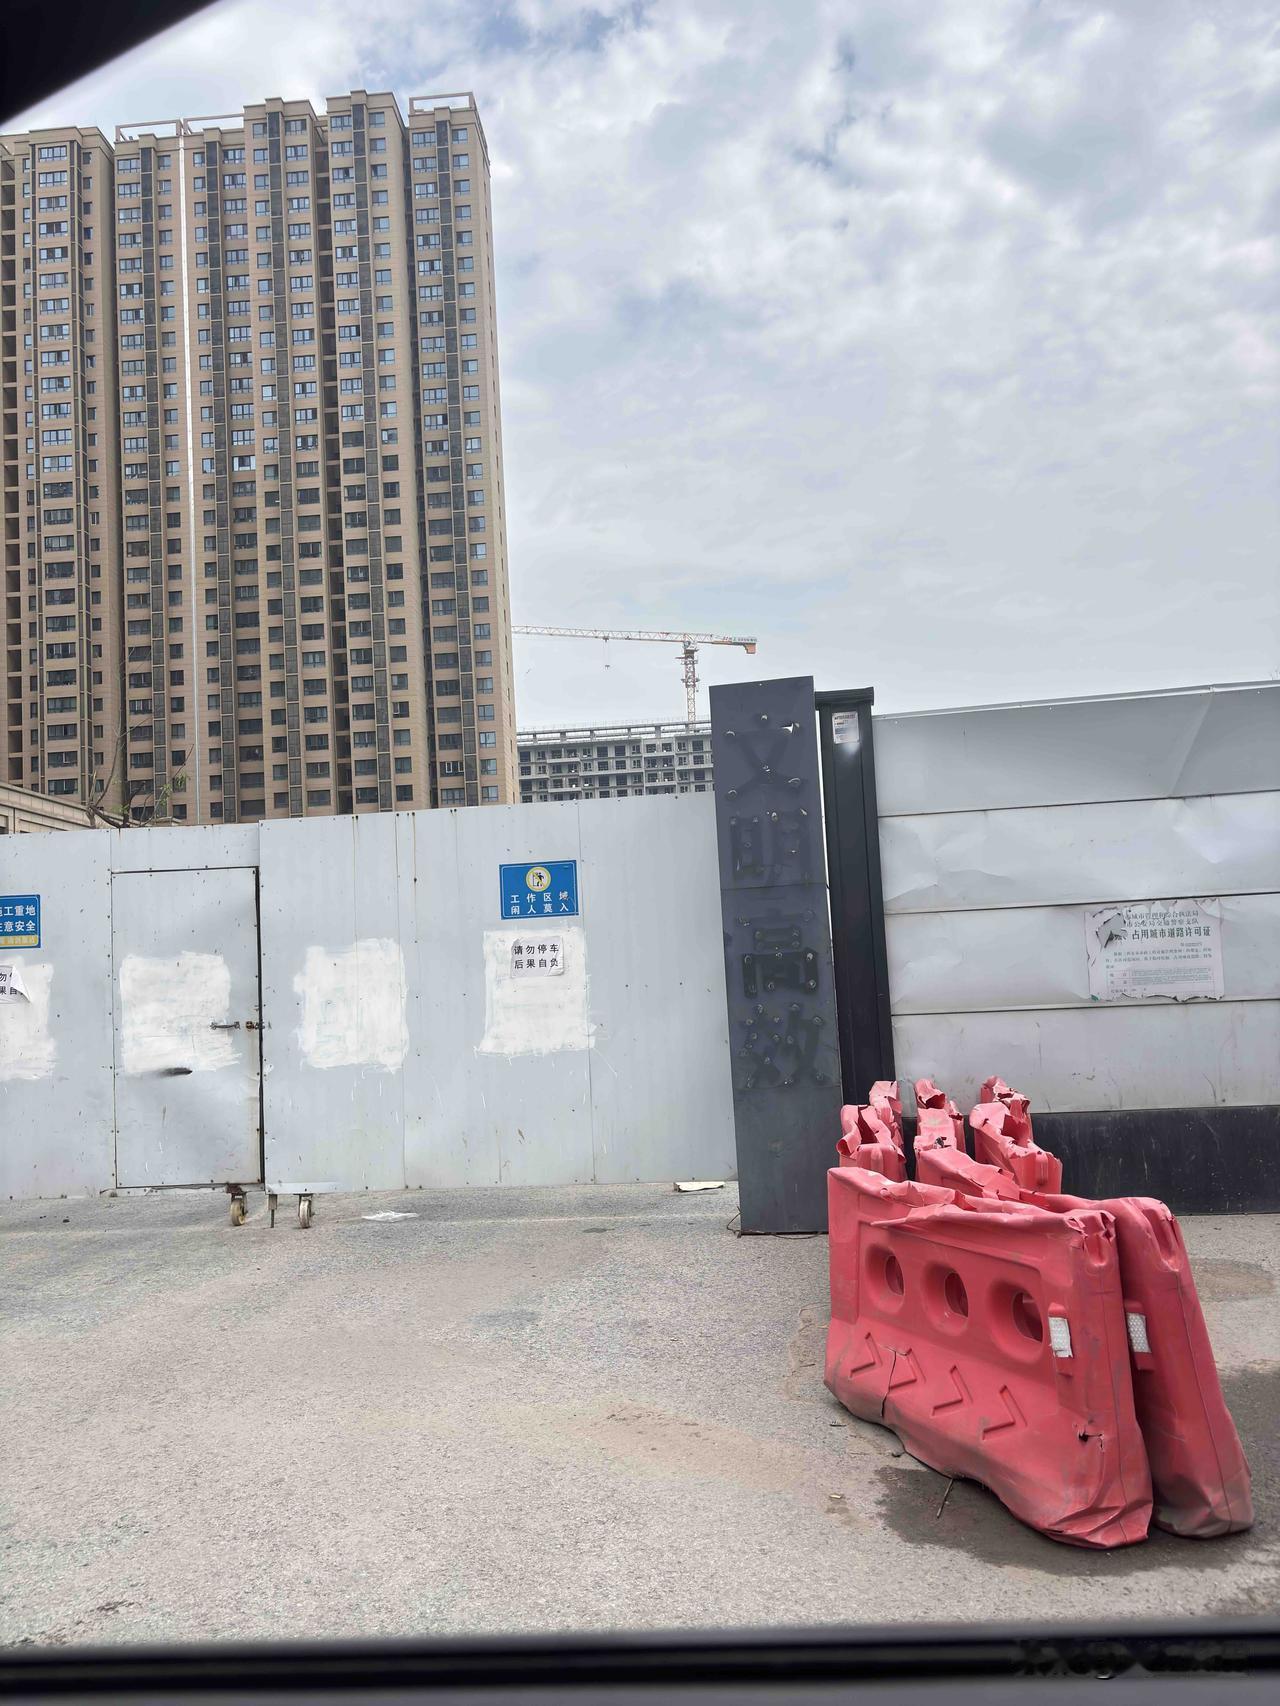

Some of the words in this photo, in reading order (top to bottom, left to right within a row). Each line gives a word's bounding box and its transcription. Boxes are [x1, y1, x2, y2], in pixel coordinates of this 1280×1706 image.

[510, 891, 568, 904] 工作区域
[0, 905, 36, 917] 工重地
[510, 903, 569, 915] 闲人莫入
[0, 920, 36, 932] 意安全
[1132, 926, 1211, 940] 占用城市道路许可证
[514, 944, 559, 955] 请勿停车
[514, 958, 559, 969] 后果自负
